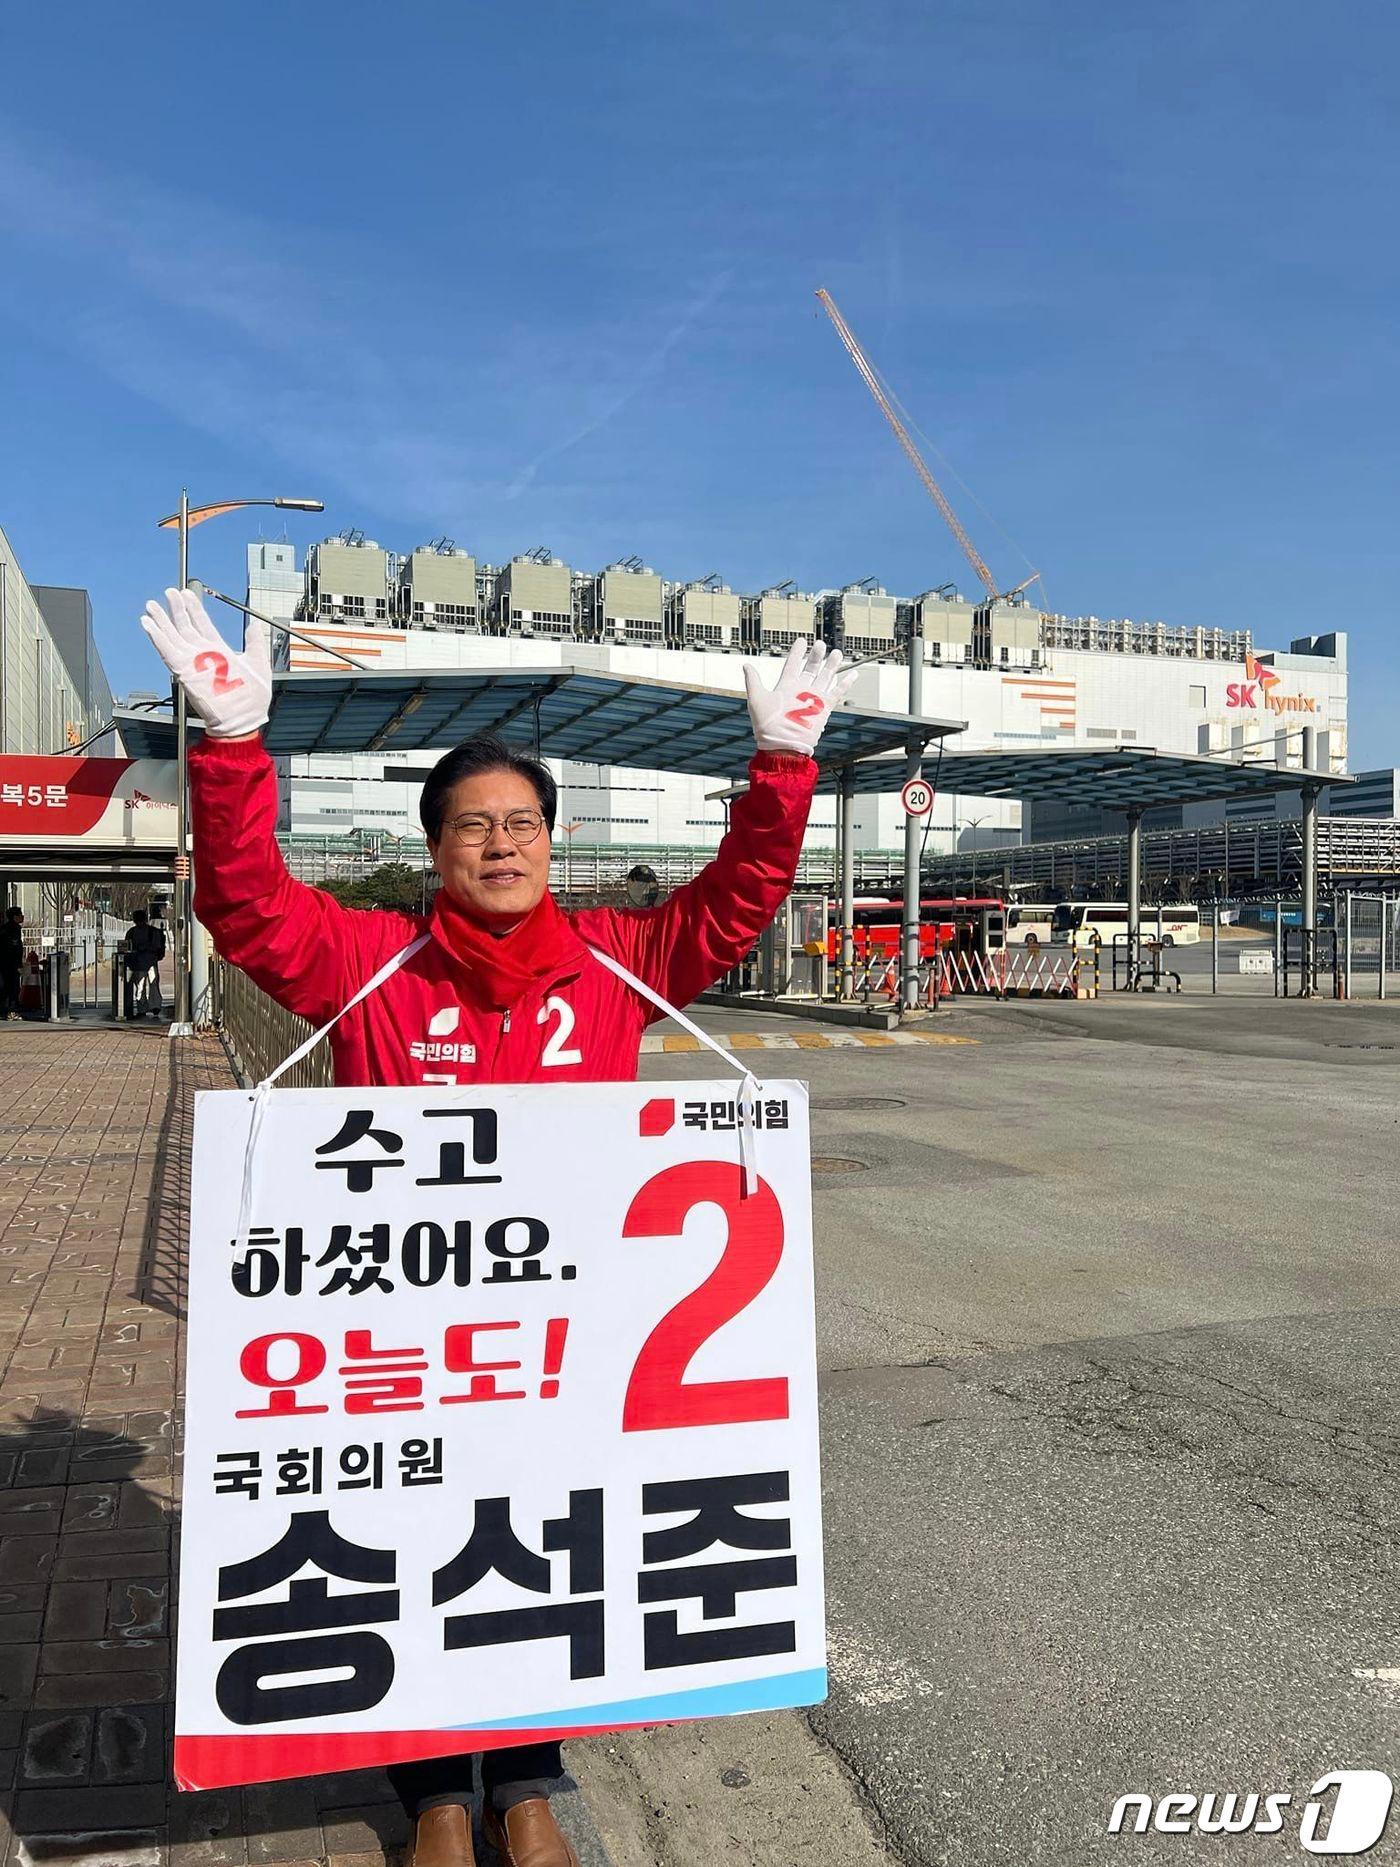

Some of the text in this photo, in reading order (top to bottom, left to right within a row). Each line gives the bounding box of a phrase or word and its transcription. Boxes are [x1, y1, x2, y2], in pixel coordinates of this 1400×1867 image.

[194, 651, 245, 697] 2
[1226, 683, 1316, 716] SK hynix
[784, 691, 825, 729] 2
[124, 799, 139, 809] SK
[910, 791, 926, 806] 20
[409, 1041, 476, 1064] 국민의힘
[536, 996, 583, 1067] 2
[682, 1099, 789, 1131] 국민의힘
[314, 1107, 502, 1193] 수고
[230, 1216, 577, 1298] 하셨어요.
[621, 1159, 790, 1433] 2
[234, 1317, 570, 1419] 오늘도!
[212, 1437, 444, 1500] 국회의원
[212, 1469, 798, 1727] 송석준
